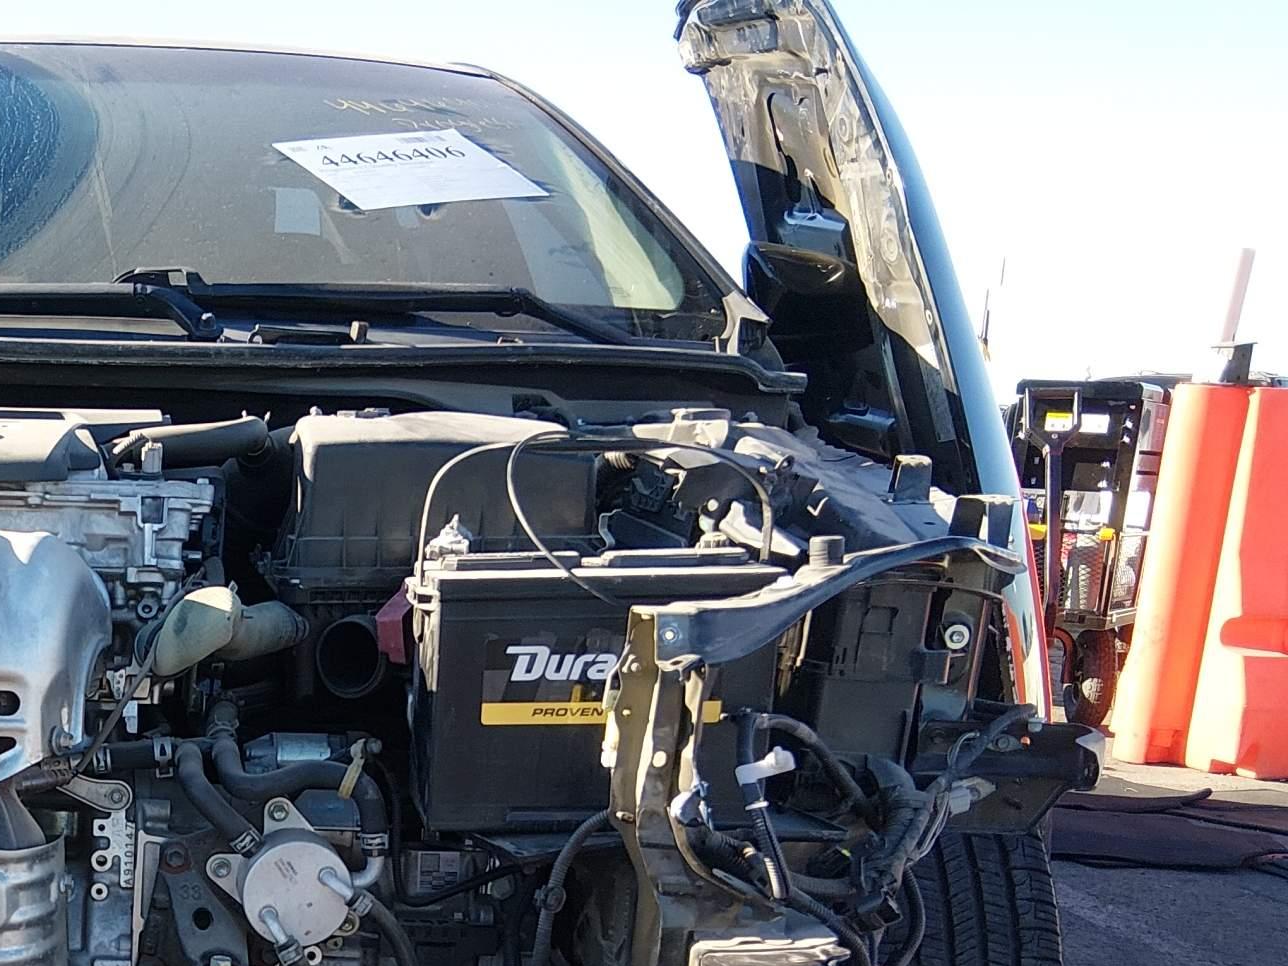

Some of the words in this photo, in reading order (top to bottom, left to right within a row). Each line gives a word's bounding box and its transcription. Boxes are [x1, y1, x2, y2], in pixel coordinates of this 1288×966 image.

[322, 146, 466, 167] 44646406
[531, 707, 604, 717] PROVEN
[123, 823, 134, 885] A910147
